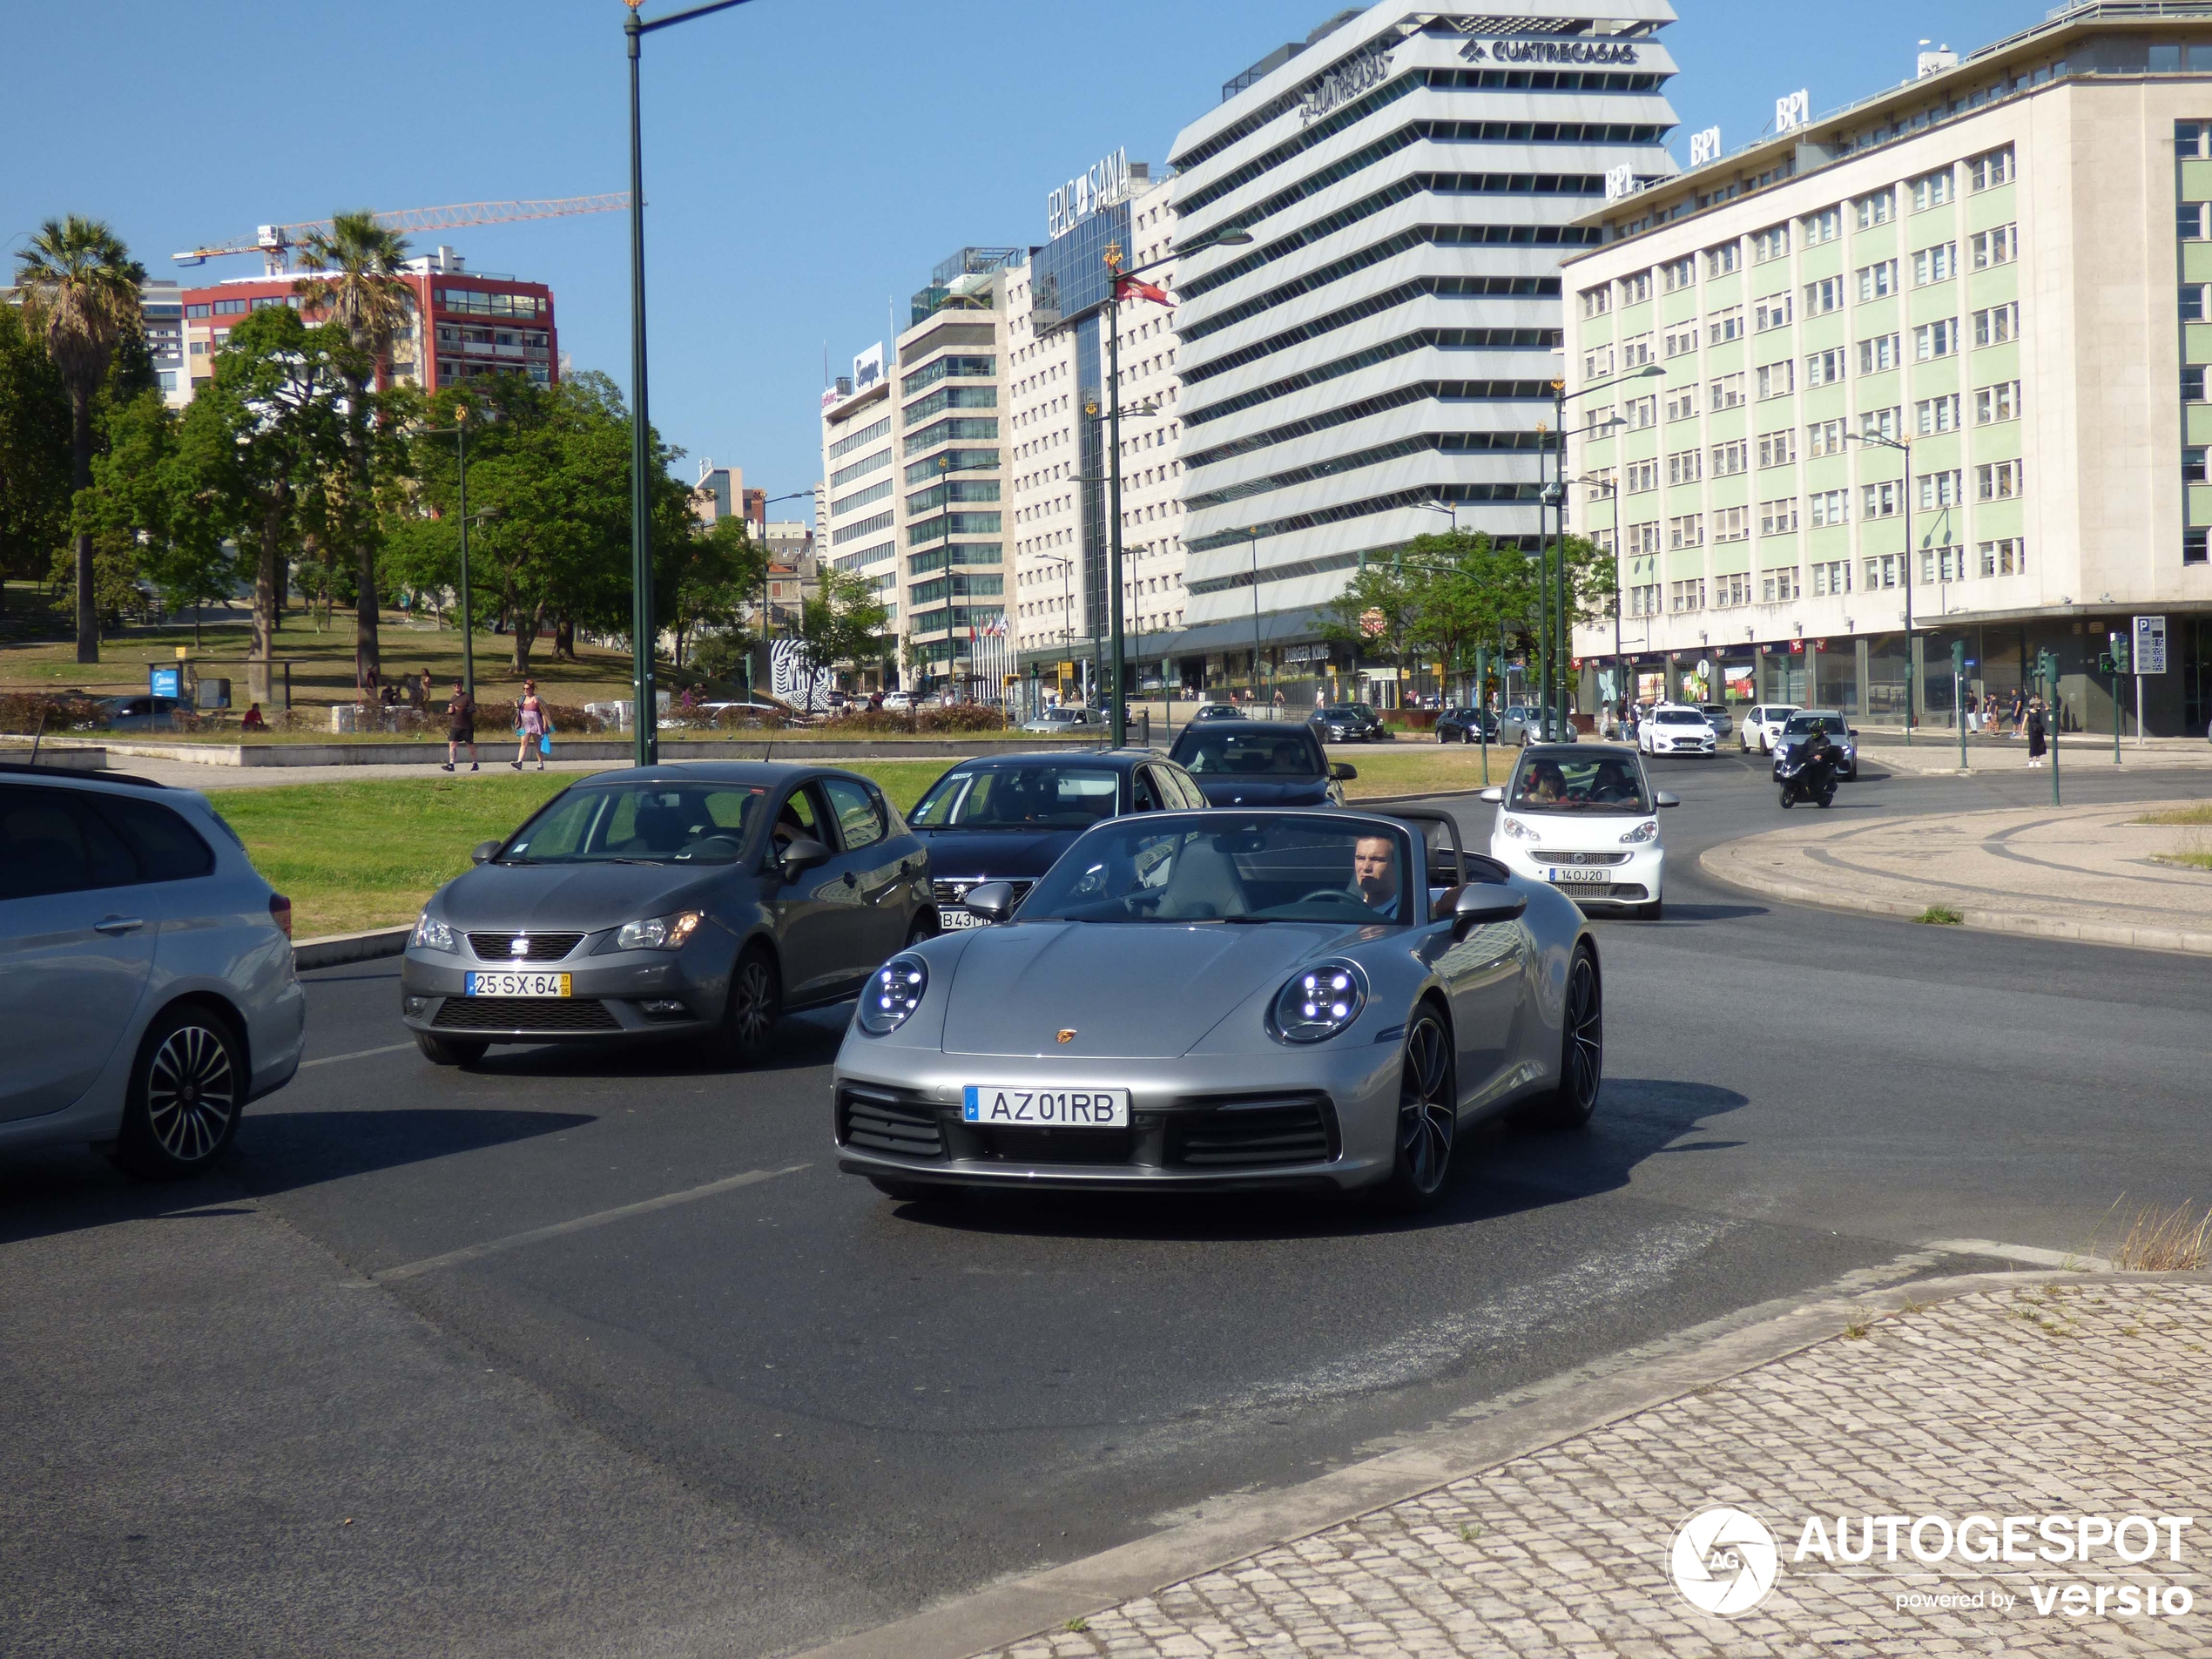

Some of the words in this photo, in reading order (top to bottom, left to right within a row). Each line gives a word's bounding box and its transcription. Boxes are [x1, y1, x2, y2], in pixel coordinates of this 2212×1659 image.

[1492, 40, 1635, 63] CUATRECASAS
[1313, 51, 1387, 115] CUATRECASAS
[1776, 87, 1810, 133] BPI
[1689, 125, 1722, 167] BPI
[1048, 179, 1076, 239] EPIC
[1089, 145, 1130, 214] SANA
[1605, 162, 1633, 201] BPI
[2139, 619, 2148, 631] P
[1285, 644, 1311, 663] BURGER
[1312, 642, 1330, 660] KING
